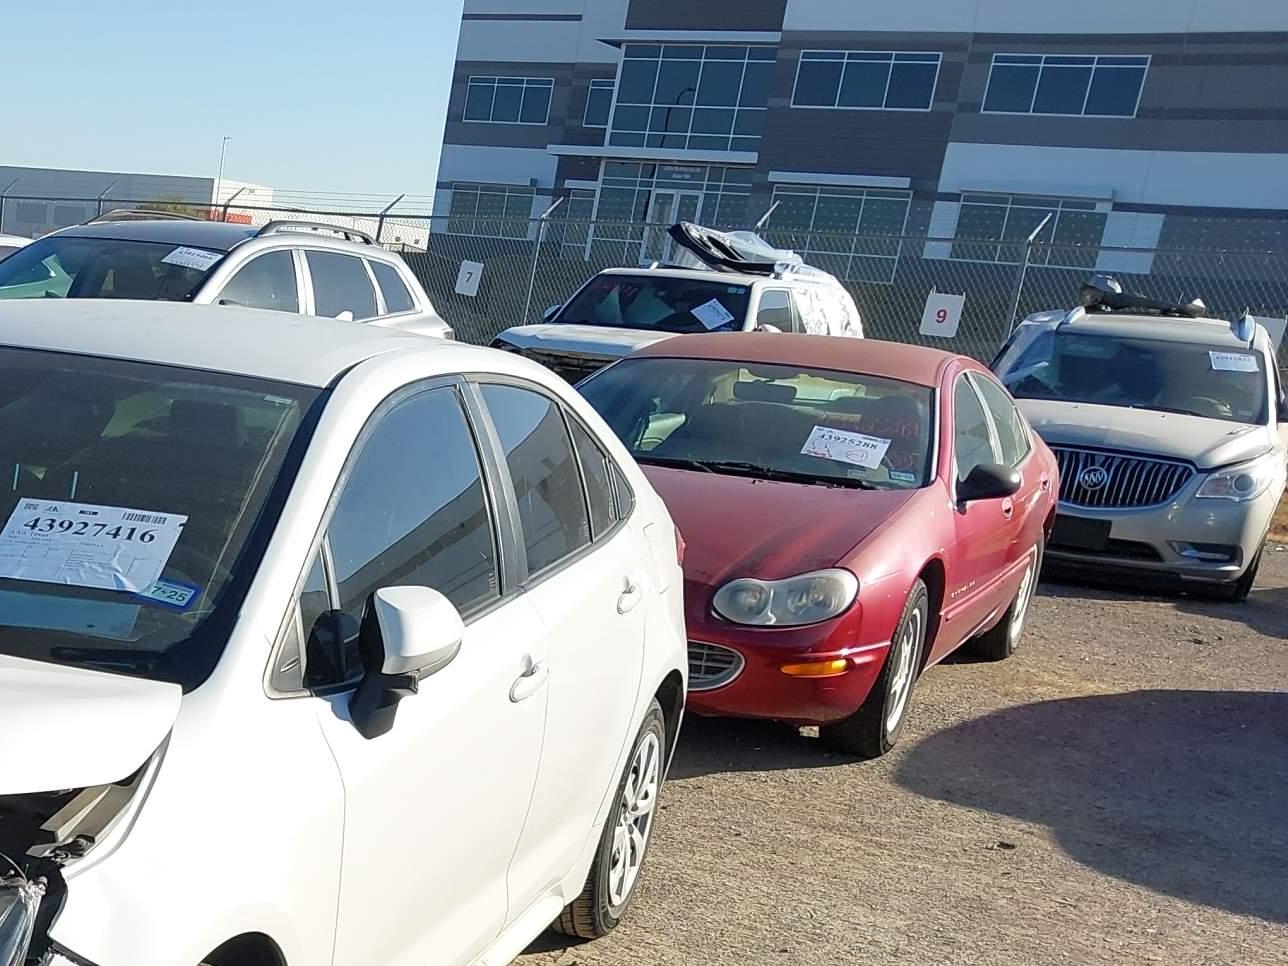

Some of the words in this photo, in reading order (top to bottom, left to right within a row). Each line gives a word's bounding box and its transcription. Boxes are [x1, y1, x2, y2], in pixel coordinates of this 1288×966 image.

[465, 271, 473, 283] 7
[936, 309, 947, 324] 9
[817, 433, 879, 450] 43925288
[23, 516, 160, 544] 43927416
